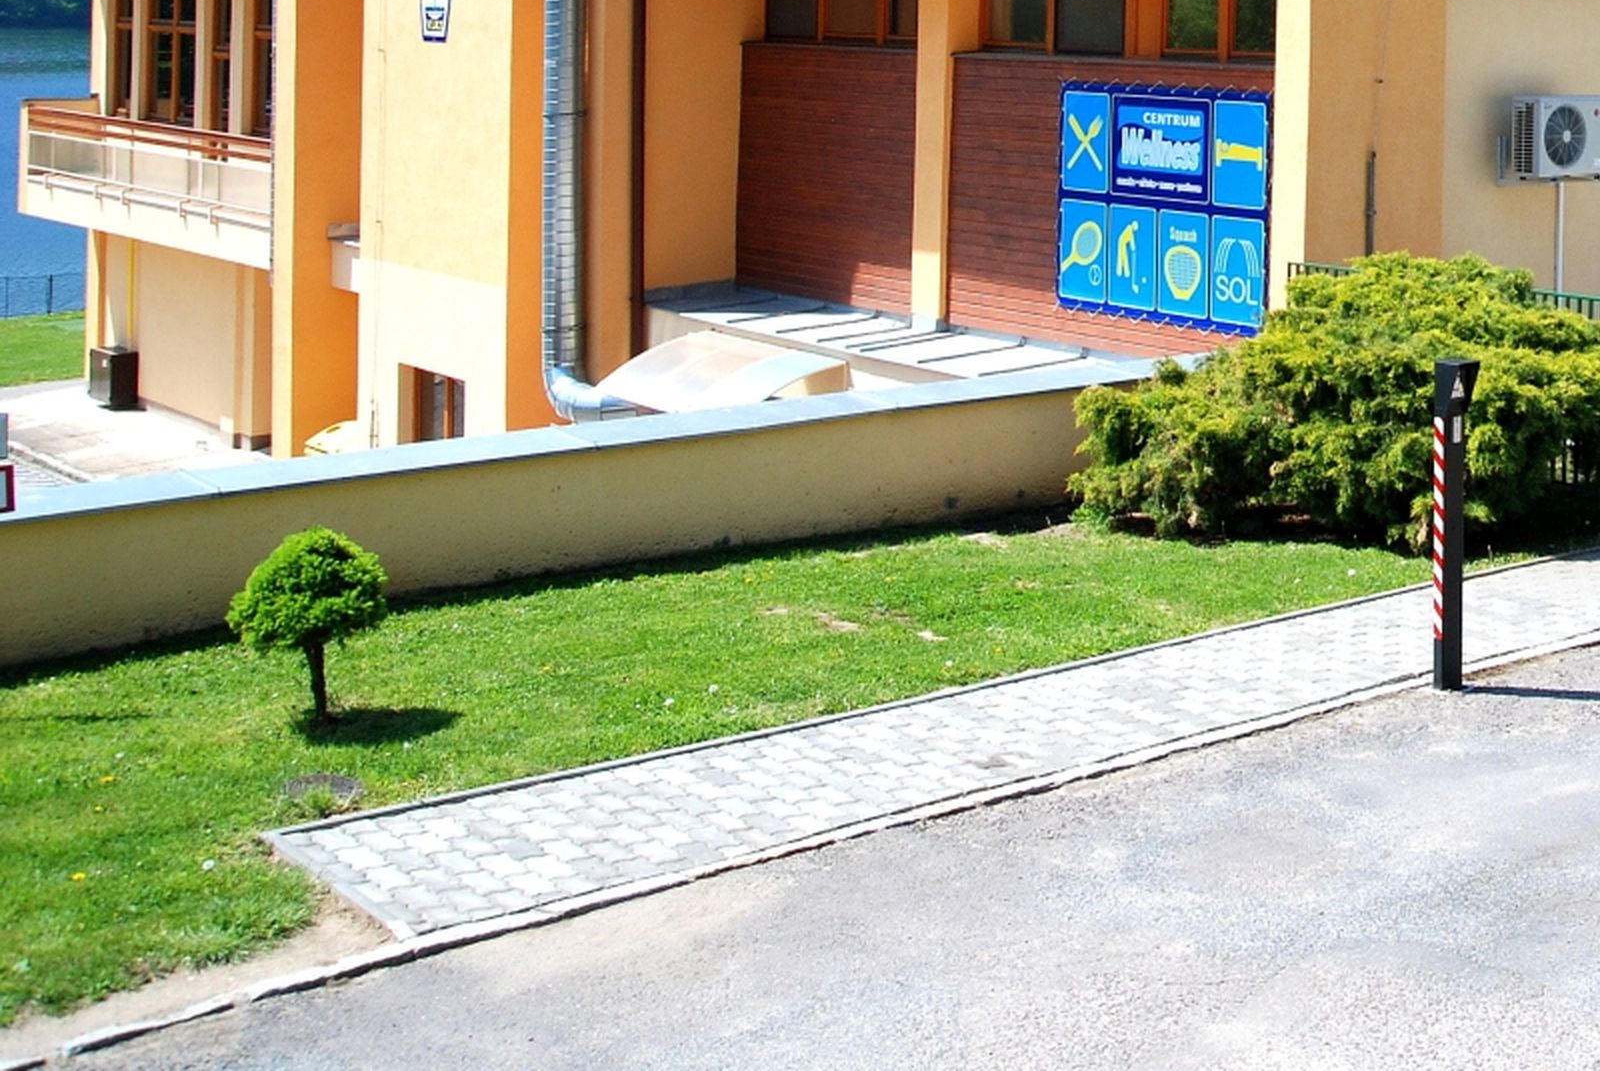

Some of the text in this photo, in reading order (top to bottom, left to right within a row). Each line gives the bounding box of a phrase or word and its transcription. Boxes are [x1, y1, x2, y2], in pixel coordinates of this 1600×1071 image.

[1142, 112, 1201, 128] CENTRUM
[1121, 127, 1201, 172] Wellness
[1215, 275, 1259, 306] SOL
